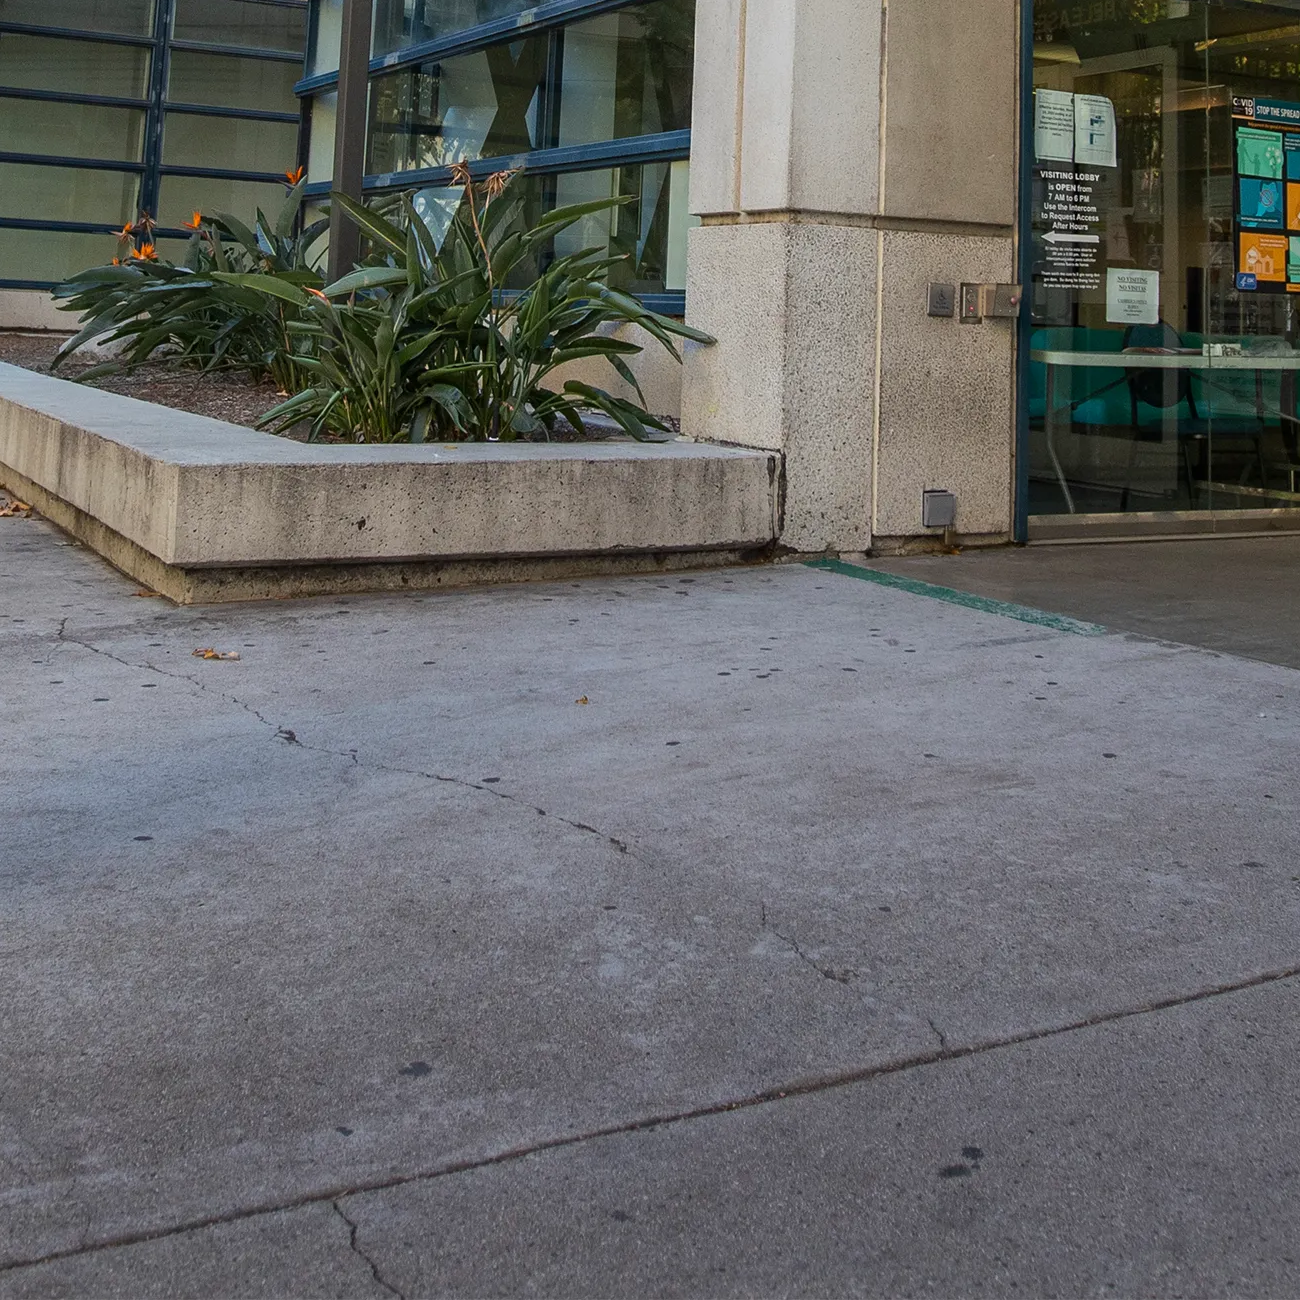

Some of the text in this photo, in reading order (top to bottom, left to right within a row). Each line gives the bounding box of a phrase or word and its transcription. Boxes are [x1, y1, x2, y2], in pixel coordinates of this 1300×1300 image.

[1244, 107, 1253, 115] 19
[1256, 106, 1269, 114] STOP
[1270, 108, 1280, 116] THE
[1281, 109, 1299, 119] SPREAD
[1040, 171, 1100, 181] VISITING LOBBY
[1044, 202, 1056, 210] Use
[1069, 204, 1096, 212] Intercom
[1049, 212, 1075, 221] Request
[1076, 214, 1099, 222] Access
